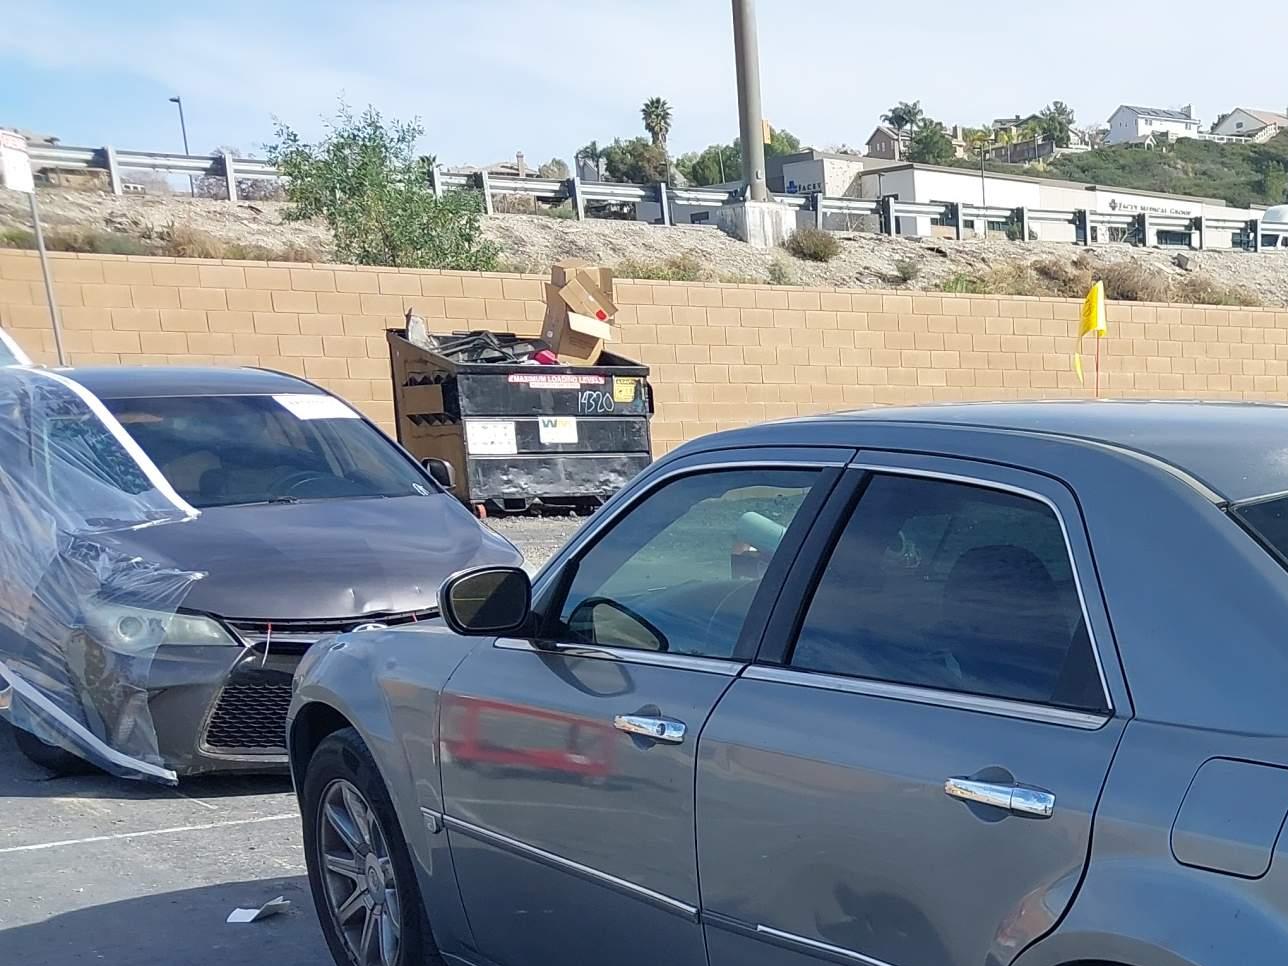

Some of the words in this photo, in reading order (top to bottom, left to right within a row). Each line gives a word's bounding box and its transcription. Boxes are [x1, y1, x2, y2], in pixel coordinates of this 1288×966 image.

[513, 374, 546, 383] MAXIMUM
[547, 375, 578, 383] LOADING
[578, 391, 615, 413] 14320
